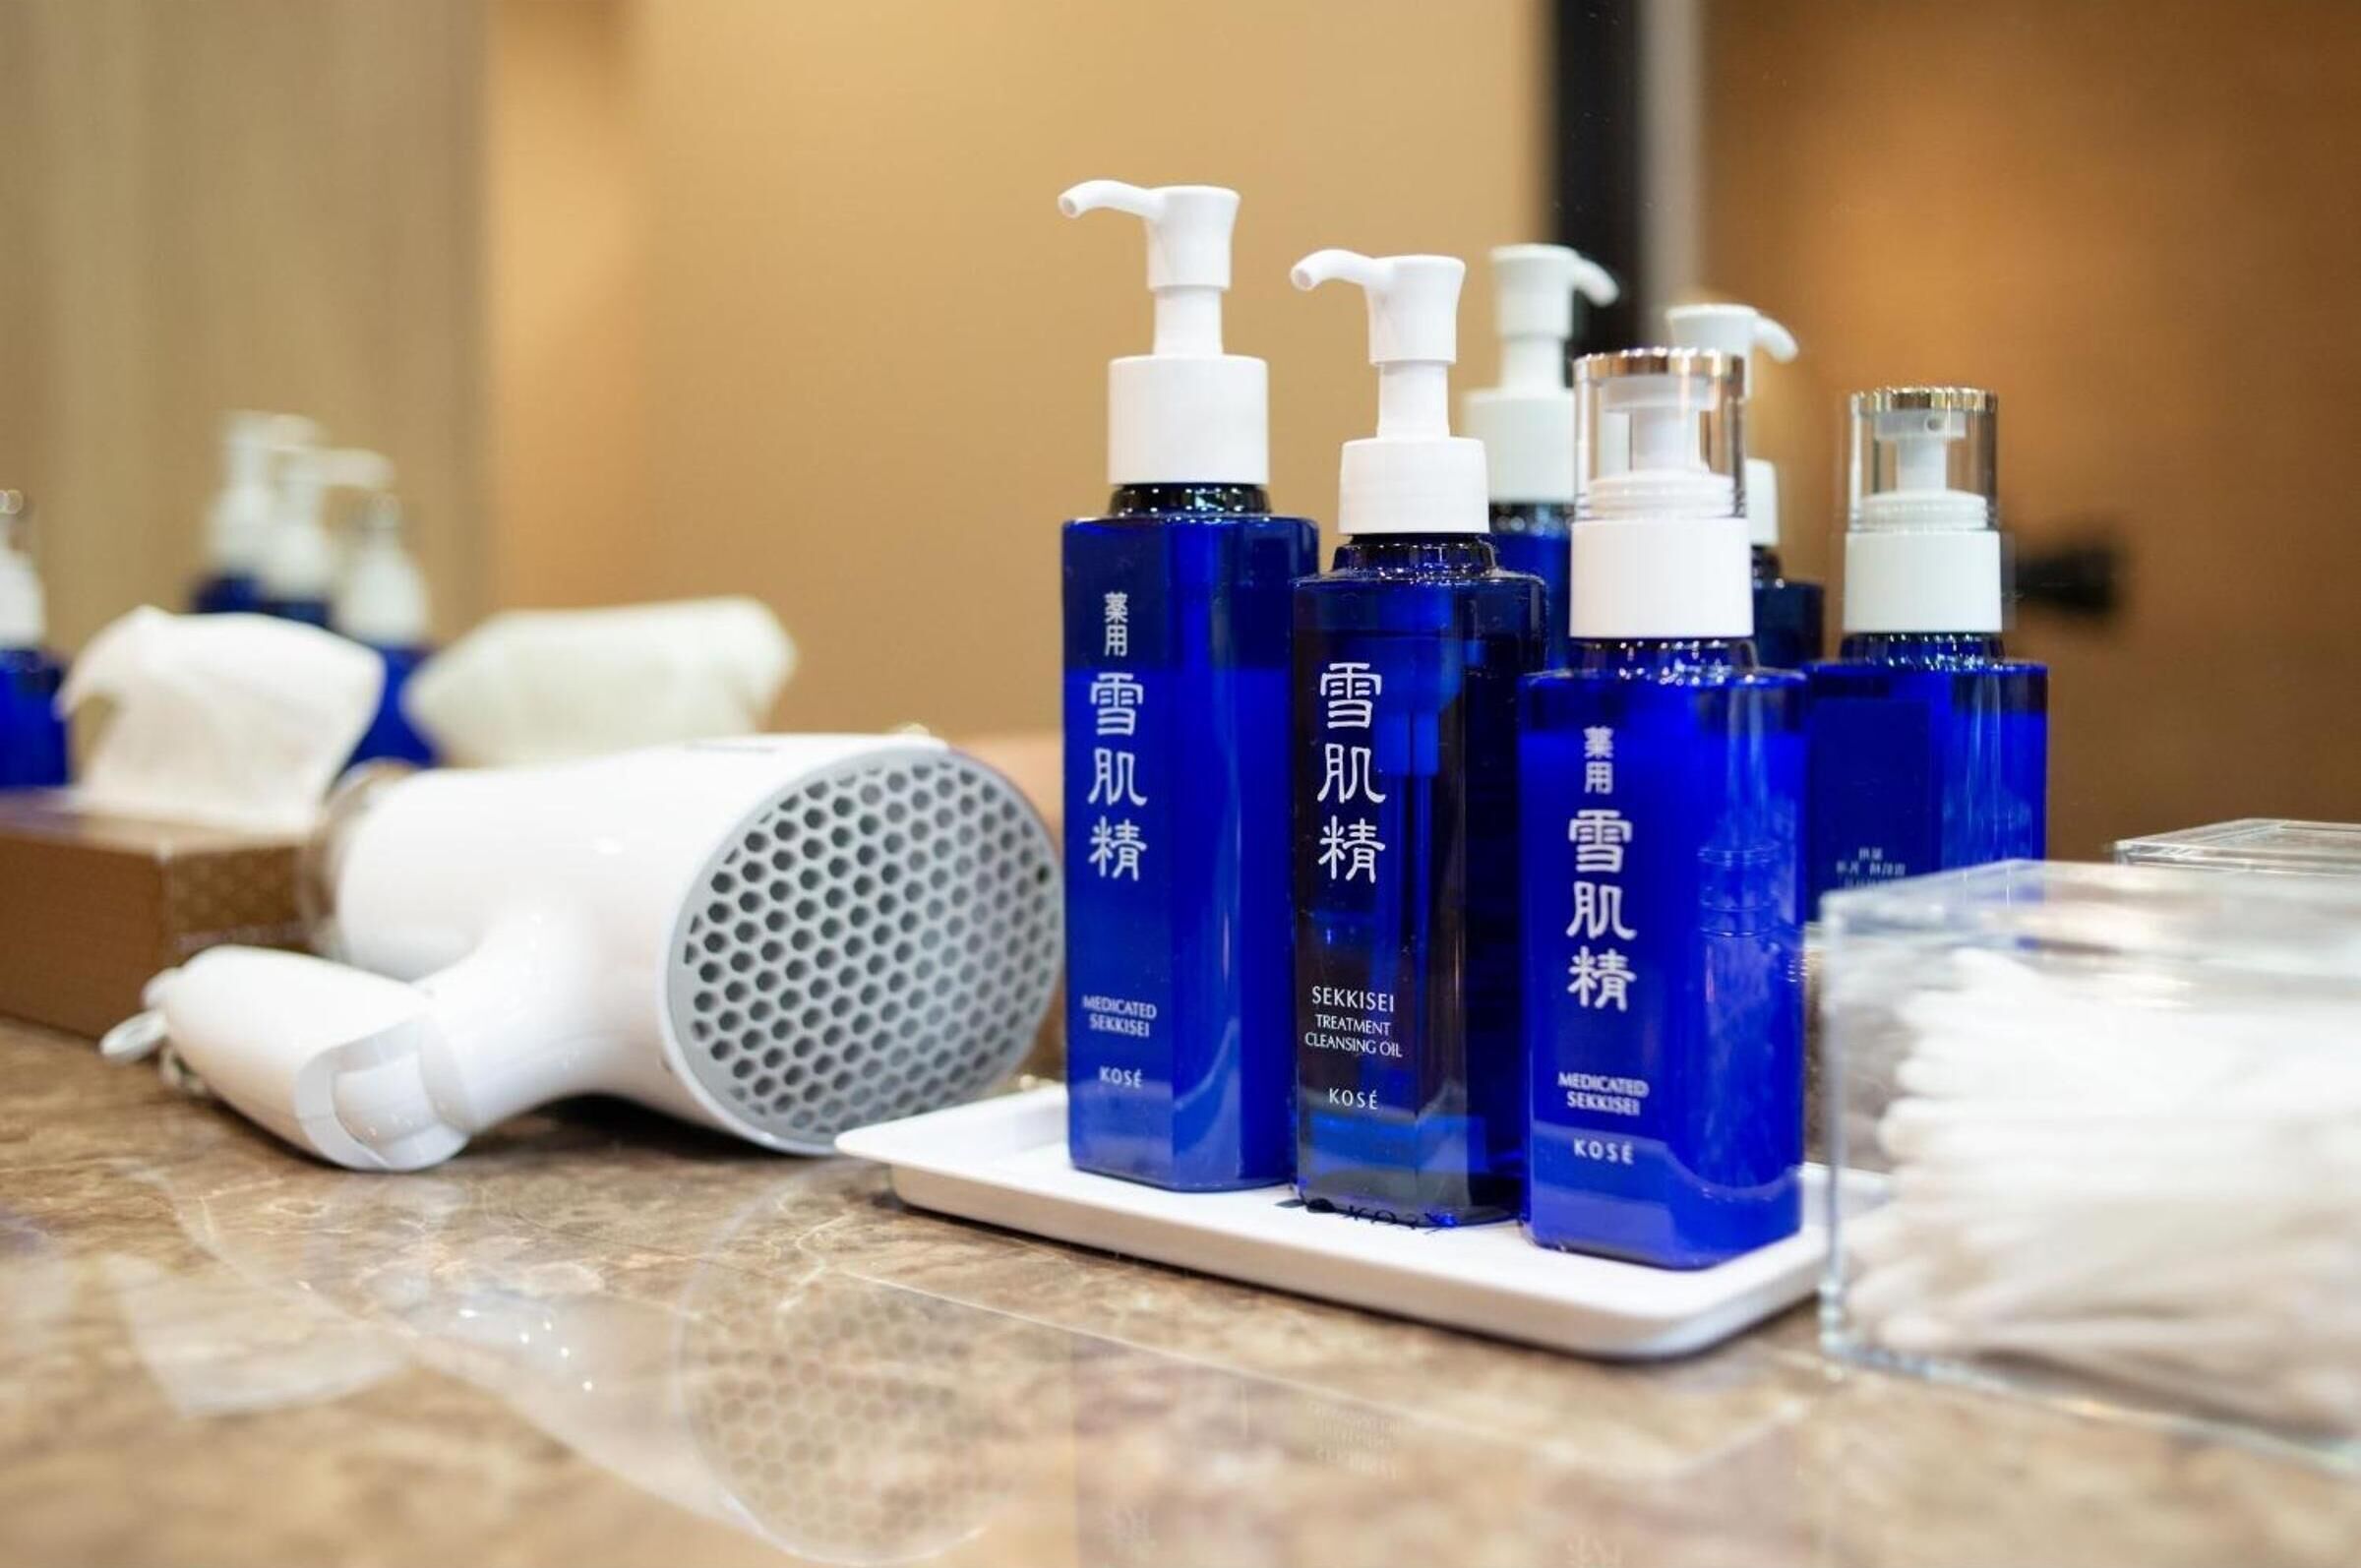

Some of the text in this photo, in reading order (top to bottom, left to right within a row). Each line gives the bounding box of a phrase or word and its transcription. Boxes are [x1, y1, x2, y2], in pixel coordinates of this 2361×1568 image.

[1104, 591, 1128, 657] 薬用
[1087, 672, 1148, 881] 雪肌精
[1316, 662, 1386, 883] 雪肌精
[1566, 810, 1638, 1011] 雪肌精
[1082, 995, 1158, 1019] MEDICATED
[1311, 985, 1395, 1013] SEKKISEI
[1089, 1012, 1150, 1038] SEKKISEI
[1314, 1013, 1392, 1037] TREATMENT
[1304, 1032, 1404, 1057] CLEANSING OIL
[1328, 1086, 1379, 1111] KOSÉ
[1557, 1071, 1651, 1099] MEDICATED
[1566, 1091, 1641, 1116] SEKKISEI
